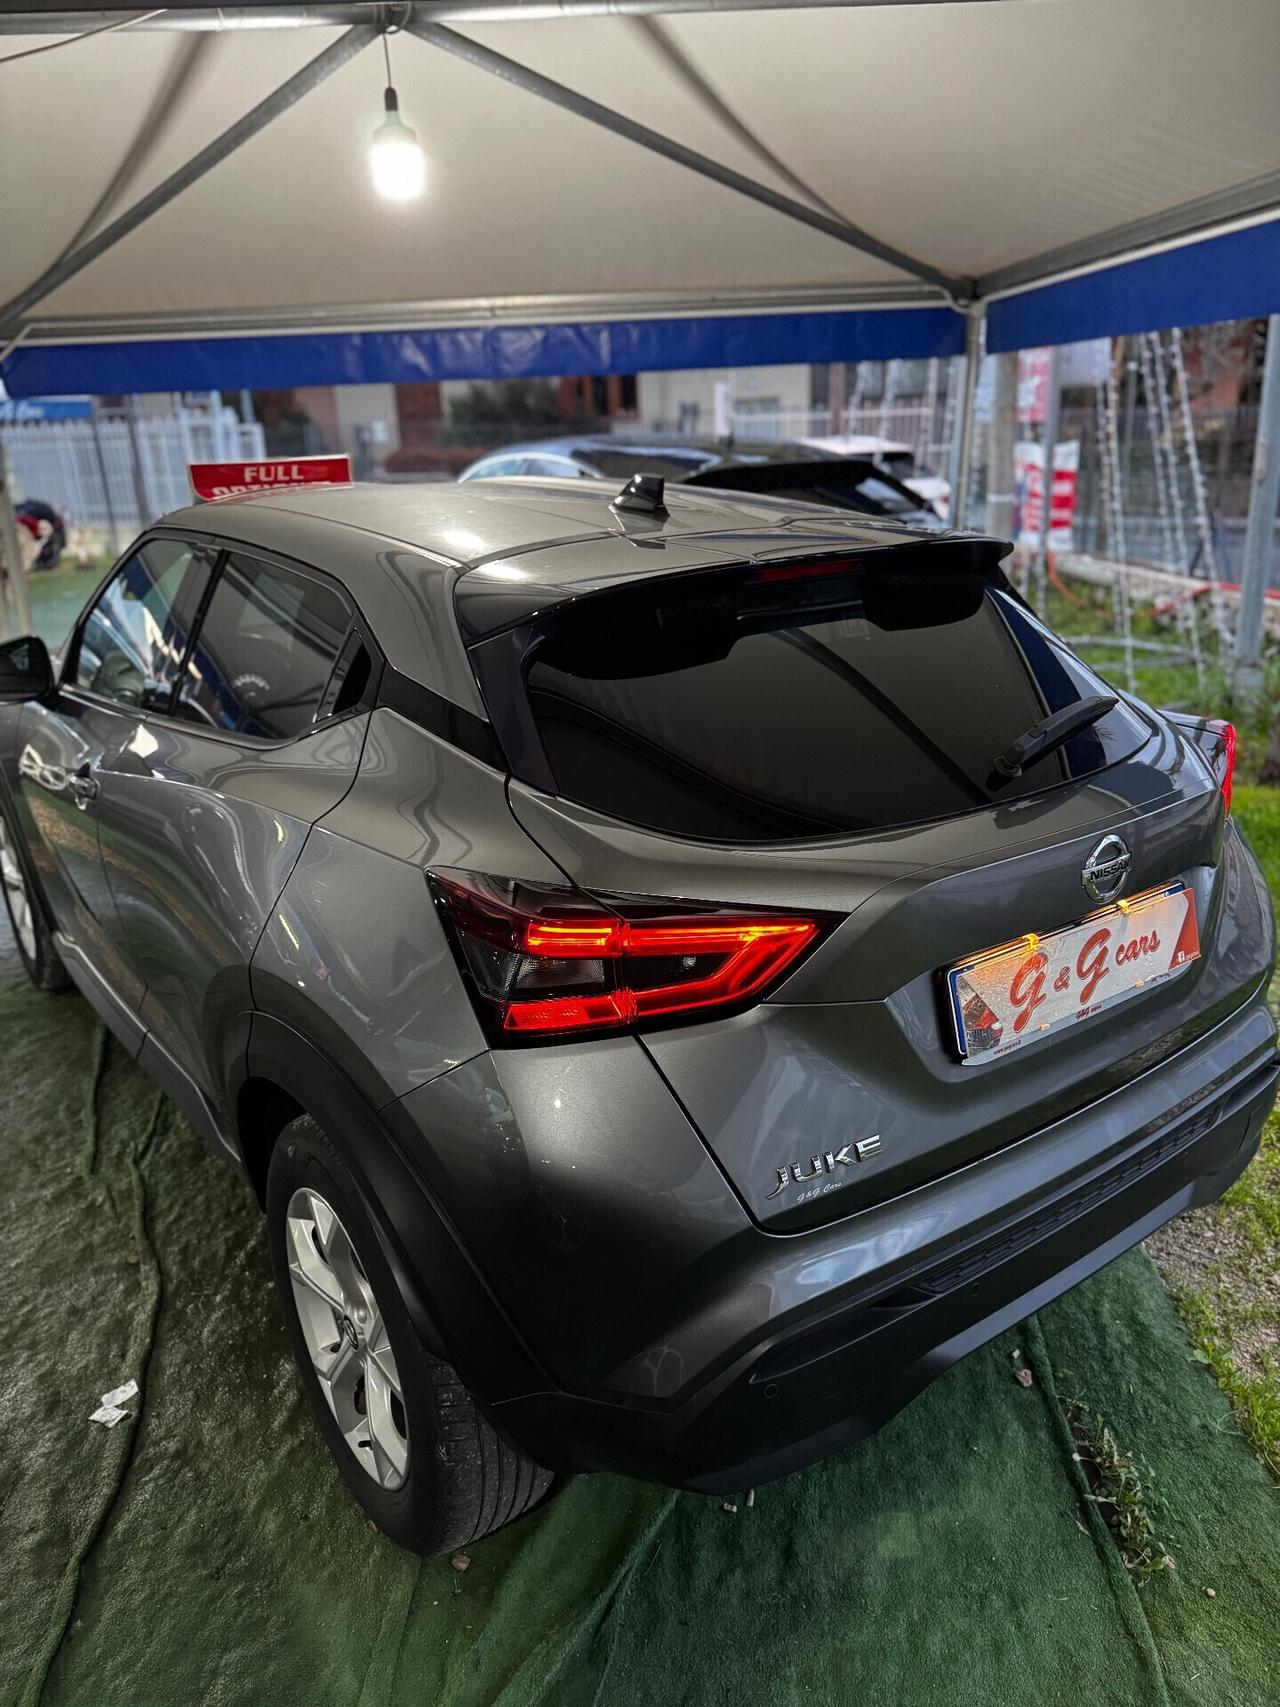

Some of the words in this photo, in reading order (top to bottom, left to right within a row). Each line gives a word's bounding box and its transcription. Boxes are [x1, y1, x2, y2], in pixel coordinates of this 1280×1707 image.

[244, 465, 304, 483] FULL
[1090, 859, 1129, 880] NISSAN
[1054, 966, 1071, 992] &
[1077, 928, 1112, 1006] G
[1116, 930, 1160, 966] cars
[766, 1134, 883, 1201] JUKE
